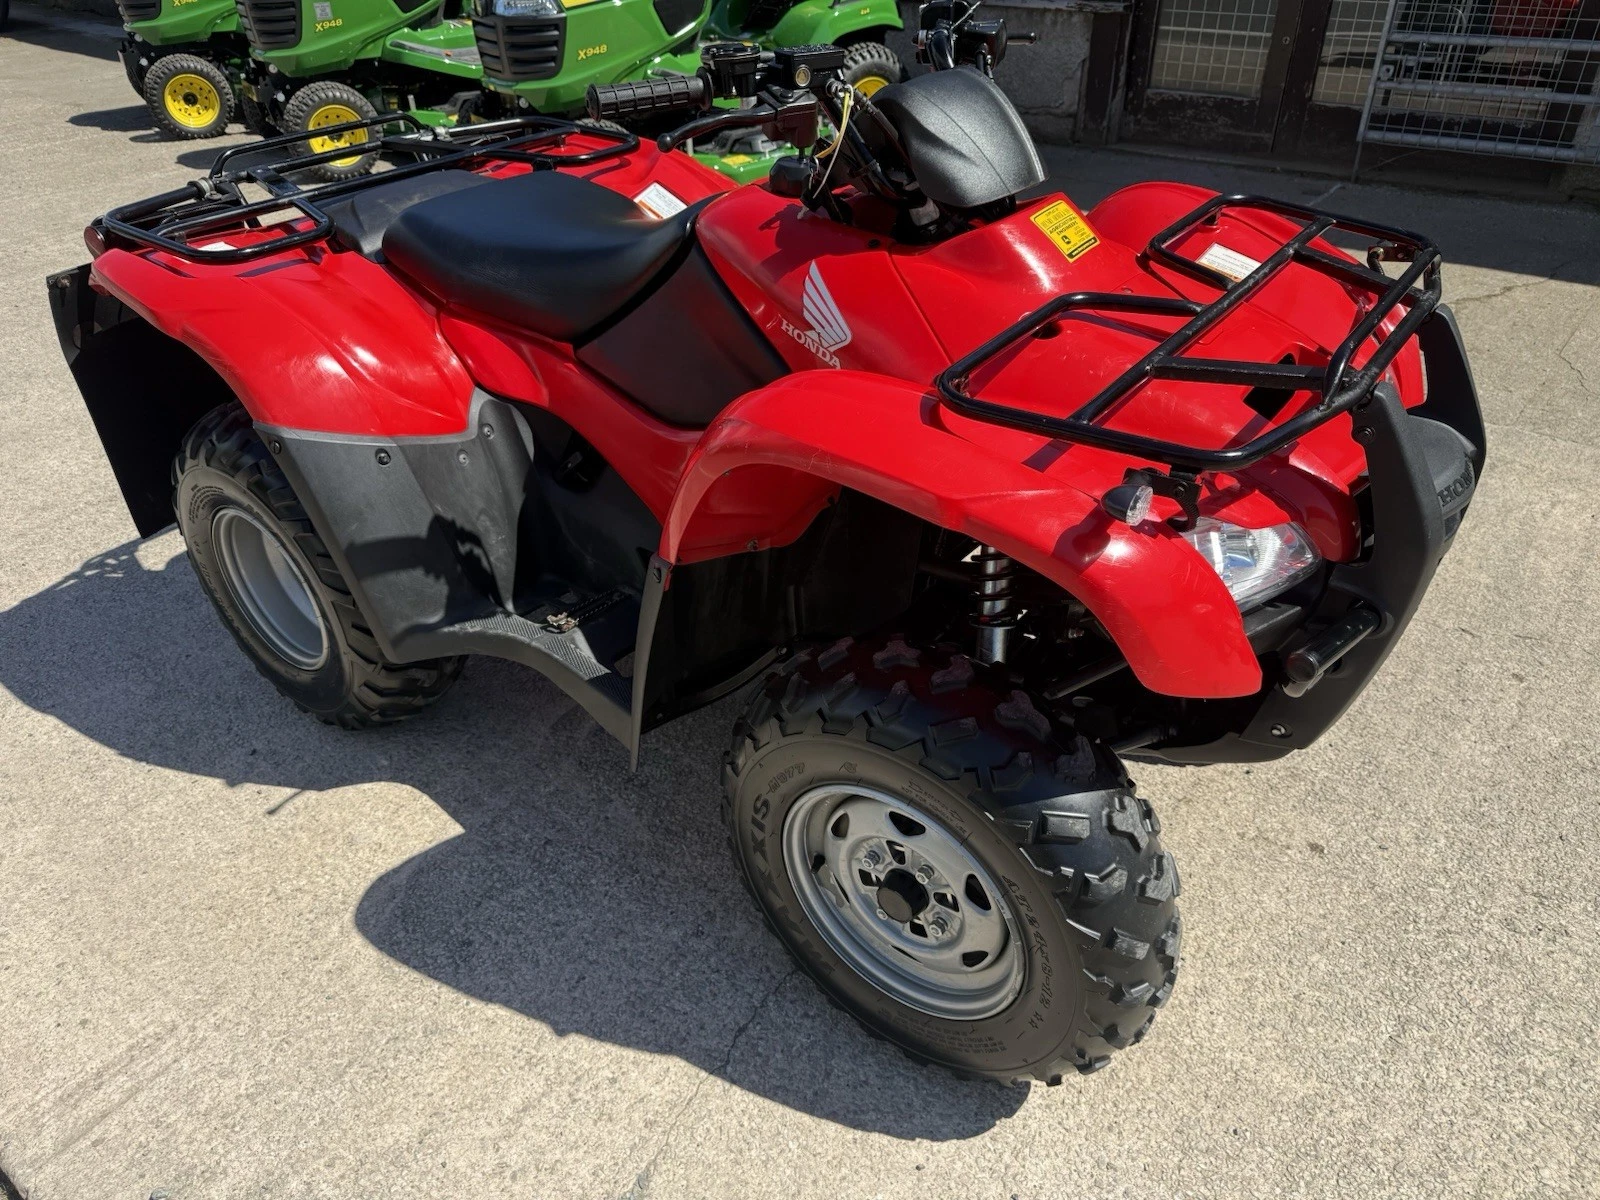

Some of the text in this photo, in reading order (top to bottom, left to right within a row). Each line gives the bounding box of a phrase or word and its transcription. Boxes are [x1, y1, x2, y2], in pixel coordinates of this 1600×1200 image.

[315, 18, 343, 32] X948
[577, 43, 608, 61] X948
[780, 318, 842, 370] HONDA
